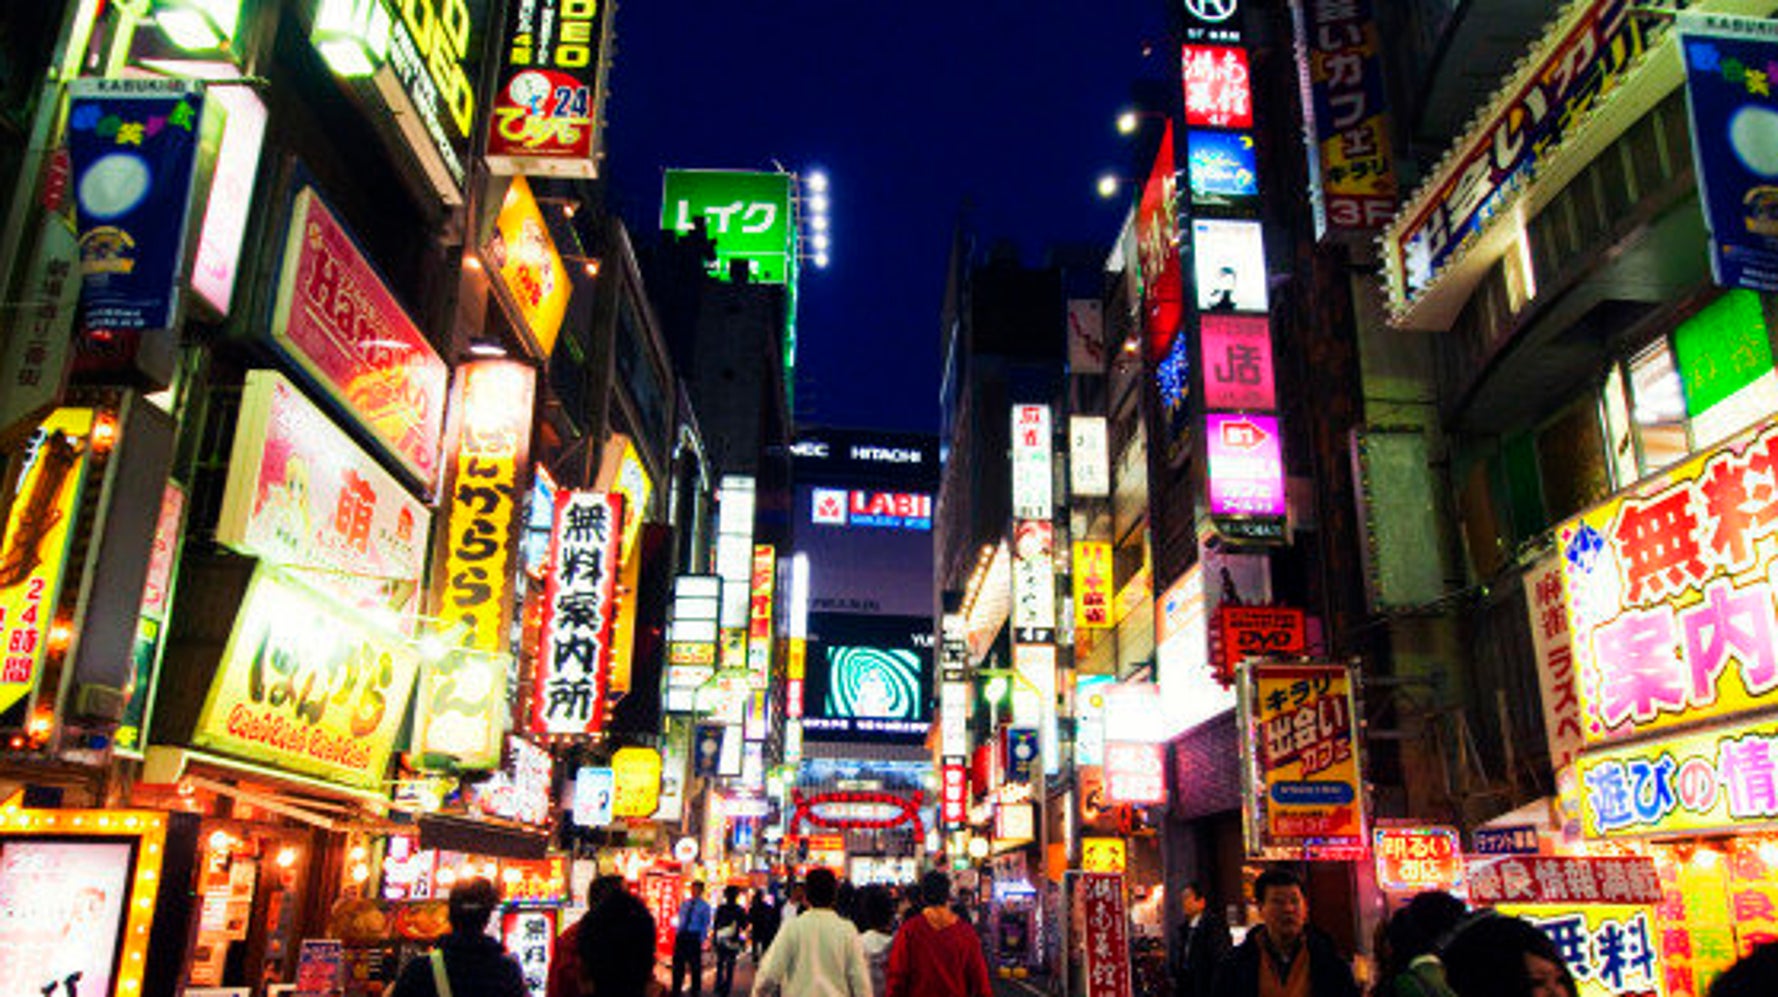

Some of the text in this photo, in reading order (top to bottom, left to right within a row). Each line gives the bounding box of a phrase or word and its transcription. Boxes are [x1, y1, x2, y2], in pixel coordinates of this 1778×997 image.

[554, 87, 588, 118] 24
[850, 445, 921, 463] HITACHI
[850, 490, 932, 518] LABI
[545, 500, 608, 722] 無料案内所
[3, 577, 46, 683] 24時間
[1238, 630, 1292, 648] DVD
[1265, 672, 1332, 711] キラリ
[1267, 697, 1343, 759] 出会い
[1301, 739, 1351, 774] カフェ
[1587, 742, 1777, 826] 遊びの情
